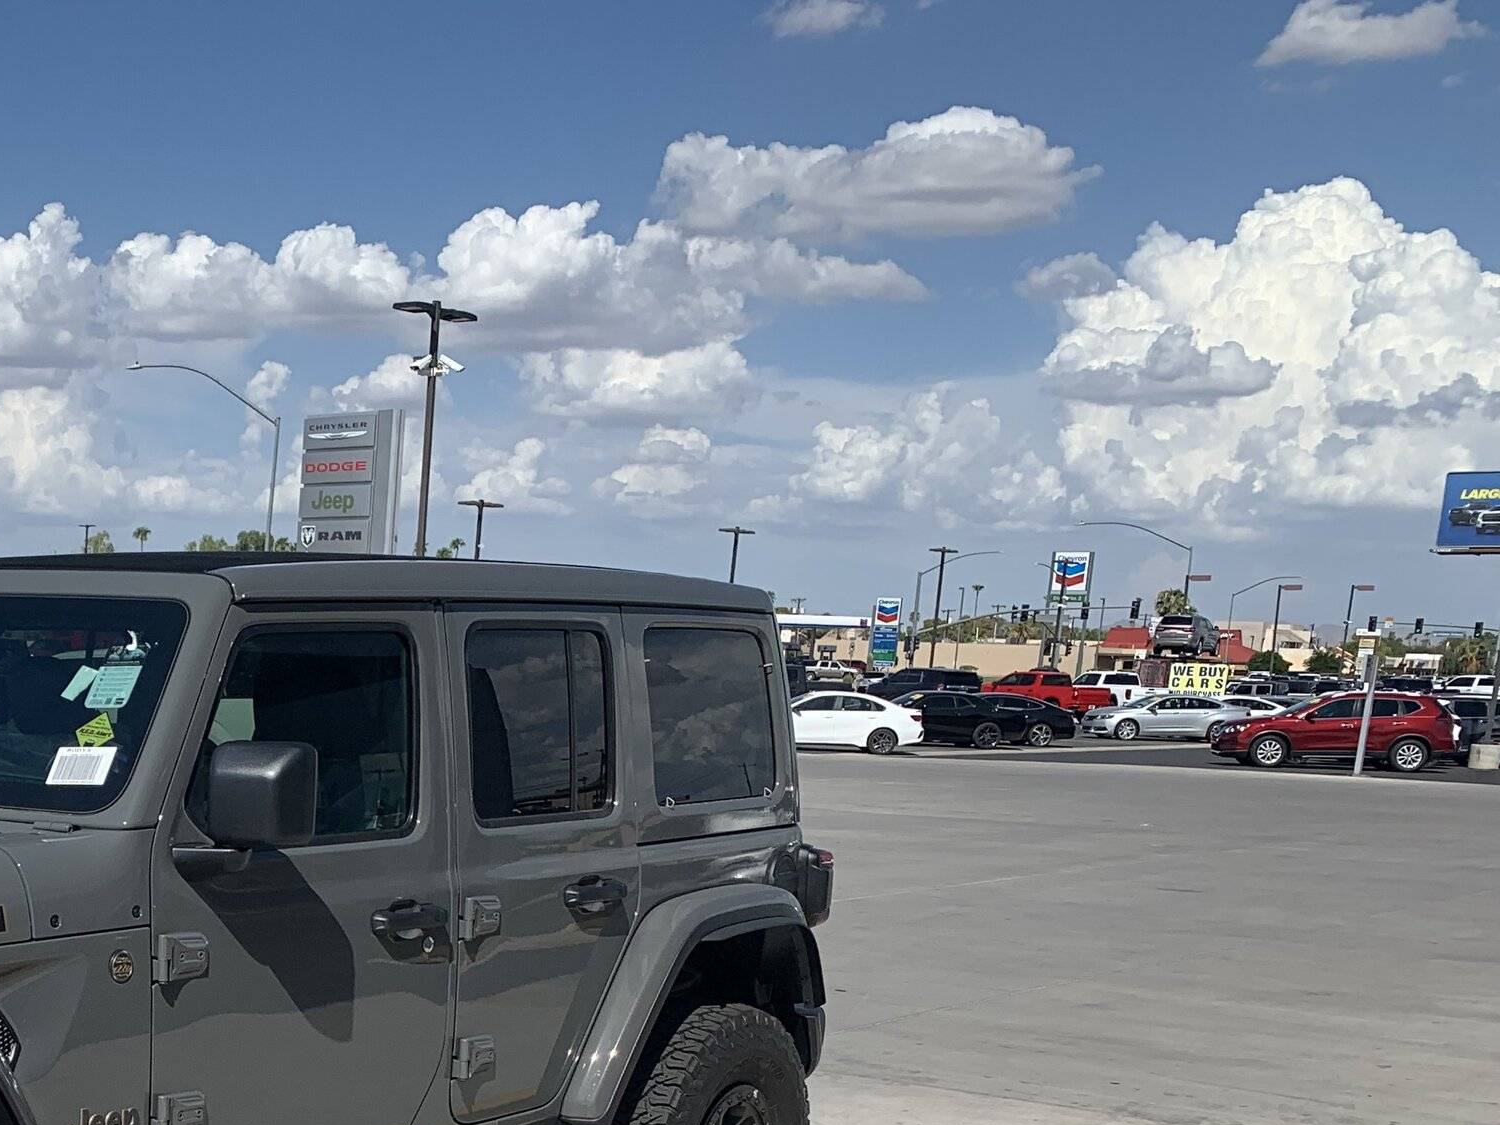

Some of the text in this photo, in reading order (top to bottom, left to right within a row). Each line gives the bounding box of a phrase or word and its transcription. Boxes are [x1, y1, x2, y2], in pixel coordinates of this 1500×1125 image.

[309, 421, 368, 431] CHRYSLER
[305, 461, 367, 473] DODGE
[311, 490, 355, 513] Jeep
[318, 530, 362, 541] RAM
[1173, 666, 1226, 677] WE BUY
[1171, 677, 1224, 689] CARS
